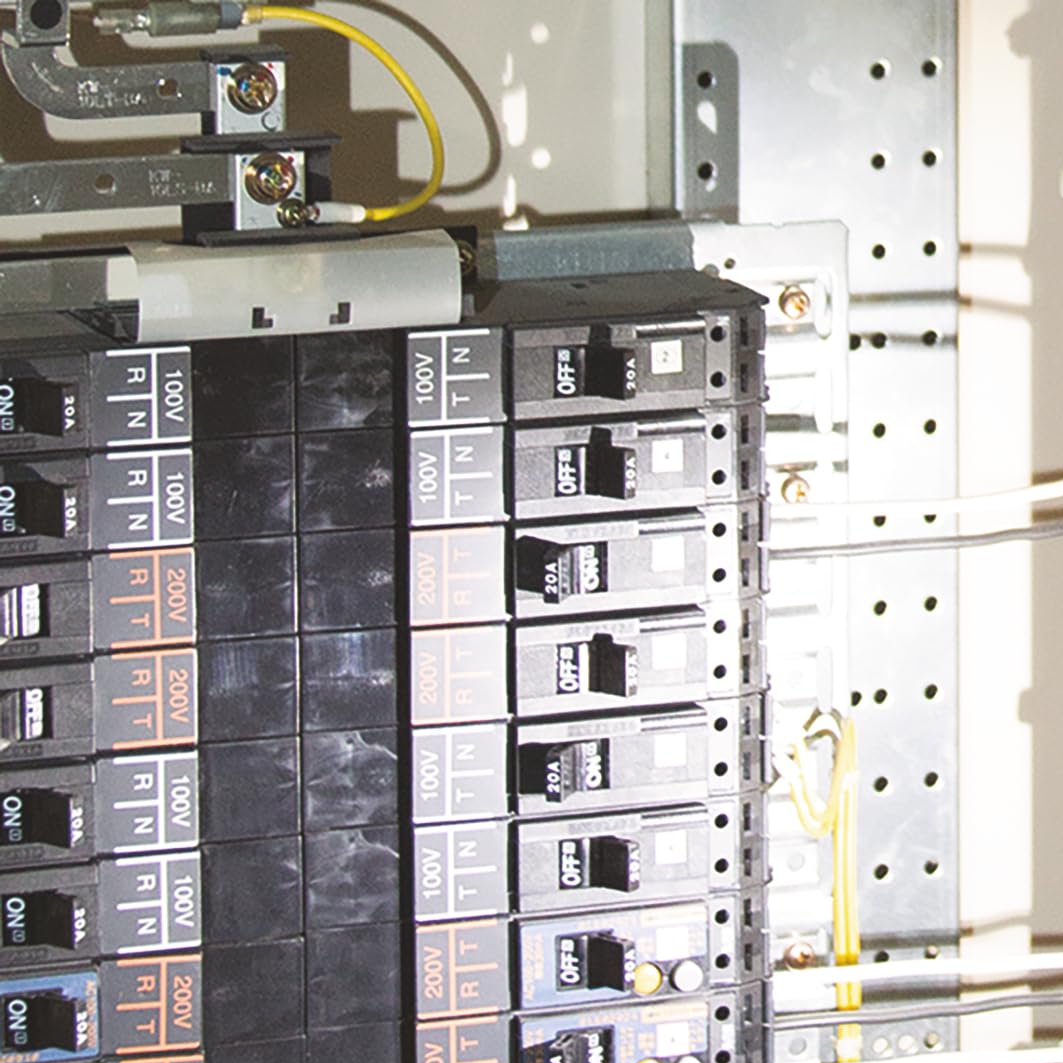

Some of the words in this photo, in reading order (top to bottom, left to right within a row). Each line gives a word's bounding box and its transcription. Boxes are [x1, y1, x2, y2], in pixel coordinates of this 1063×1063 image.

[452, 348, 470, 362] N
[127, 368, 146, 383] R
[416, 353, 434, 404] 100V
[557, 361, 576, 395] OFF
[626, 358, 636, 390] 20A
[0, 385, 14, 415] ON
[165, 370, 184, 422] 100V
[452, 392, 470, 406] T
[65, 396, 75, 429] 20A
[128, 412, 146, 428] N
[456, 447, 473, 462] N
[128, 470, 147, 486] R
[419, 452, 437, 503] 100V
[558, 460, 576, 494] OFF
[626, 457, 636, 490] 20A
[0, 486, 15, 516] ON
[166, 472, 185, 524] 100V
[456, 492, 473, 506] T
[65, 497, 76, 531] 20A
[129, 514, 147, 530] N
[129, 569, 148, 585] R
[418, 552, 435, 604] 200V
[545, 562, 558, 594] 20A
[167, 569, 187, 622] 200V
[131, 613, 149, 627] T
[132, 670, 150, 686] R
[420, 652, 438, 704] 200V
[560, 658, 580, 692] OFF
[169, 669, 190, 723] 200V
[133, 714, 152, 728] T
[458, 744, 474, 760] N
[134, 774, 153, 790] R
[420, 750, 439, 800] 100V
[548, 762, 560, 792] 20A
[586, 754, 601, 788] ON
[3, 796, 22, 827] ON
[171, 776, 191, 827] 100V
[457, 790, 474, 803] T
[72, 808, 83, 843] 20A
[134, 818, 153, 834] N
[460, 842, 476, 856] N
[137, 875, 156, 891] R
[423, 848, 441, 899] 100V
[562, 854, 580, 886] OFF
[174, 876, 194, 927] 100V
[459, 886, 476, 900] T
[7, 897, 25, 927] ON
[75, 908, 86, 942] 20A
[138, 918, 156, 935] N
[460, 941, 478, 955] T
[424, 946, 443, 999] 200V
[560, 952, 580, 984] OFF
[136, 976, 156, 992] R
[461, 981, 478, 997] R
[8, 1000, 27, 1030] ON
[173, 976, 192, 1029] 200V
[77, 1012, 88, 1045] 20A
[136, 1020, 156, 1034] T
[462, 1038, 479, 1050] T
